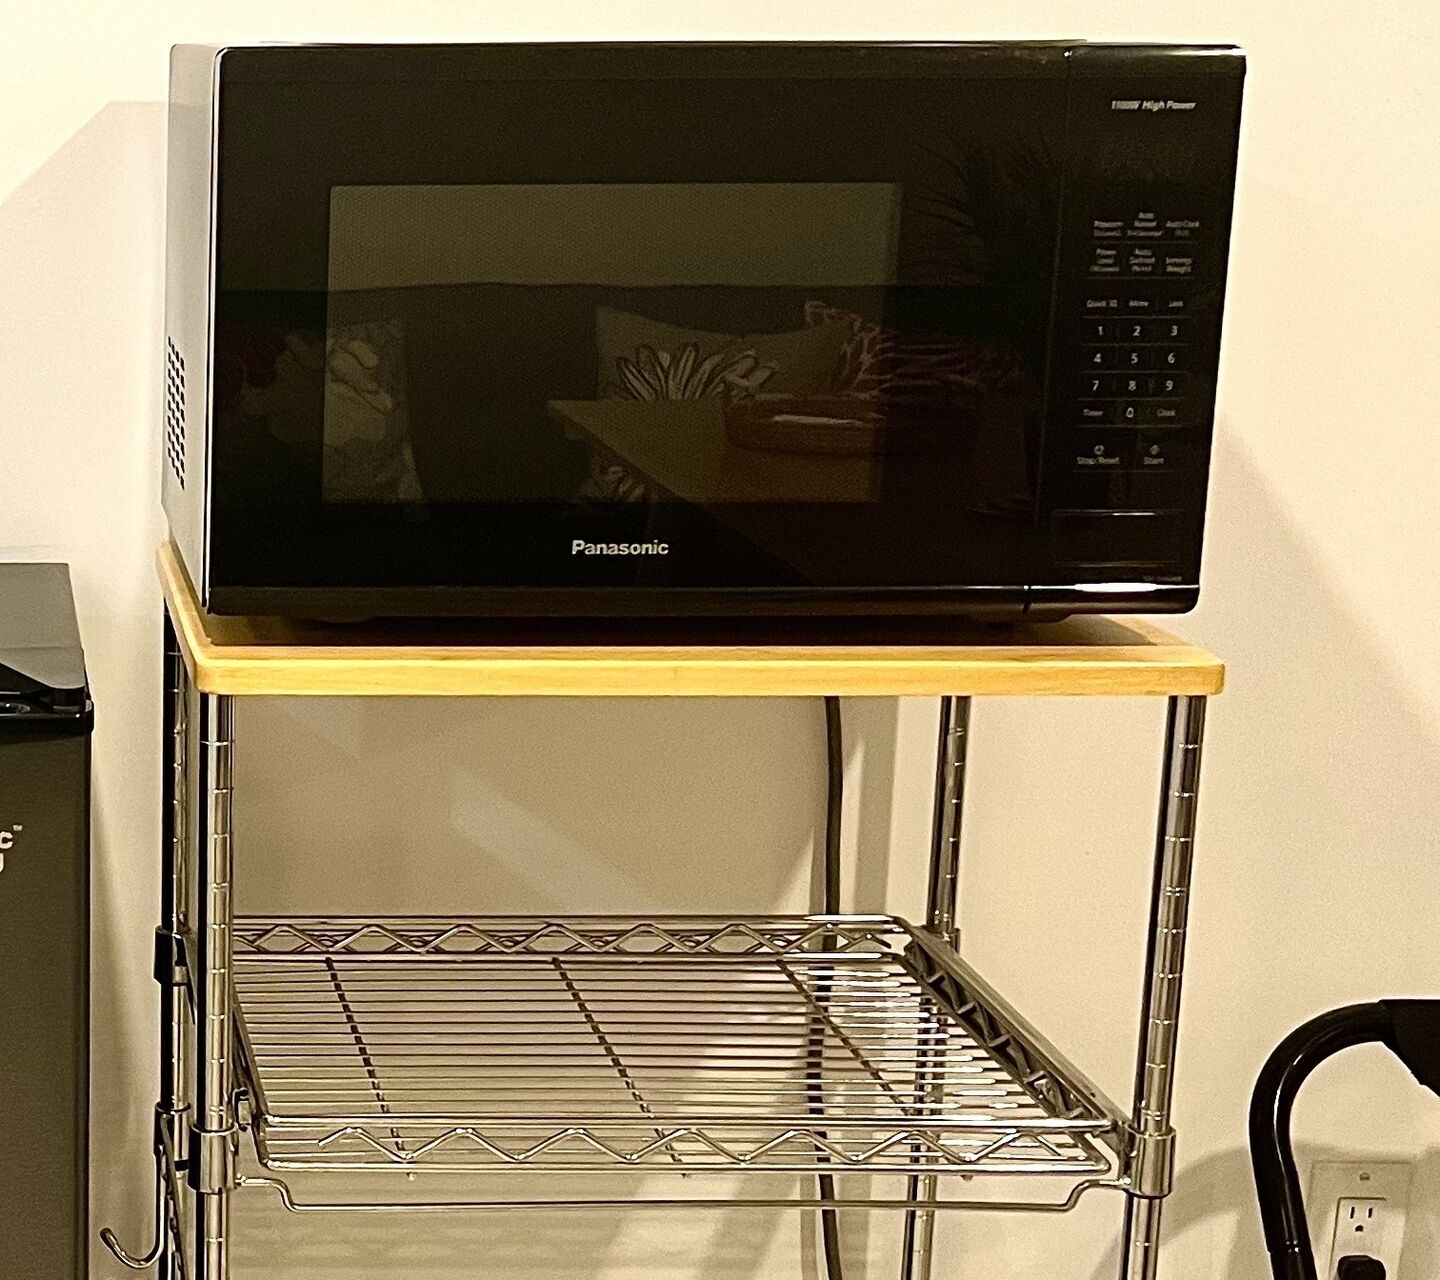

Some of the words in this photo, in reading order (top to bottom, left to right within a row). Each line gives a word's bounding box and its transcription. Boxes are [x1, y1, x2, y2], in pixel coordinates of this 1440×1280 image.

[1142, 100, 1165, 112] High
[1166, 100, 1197, 110] Power
[1097, 325, 1104, 336] 1
[1132, 325, 1141, 337] 2
[1170, 325, 1178, 337] 3
[1093, 352, 1102, 363] 4
[1131, 352, 1139, 364] 5
[1167, 352, 1175, 364] 6
[1092, 380, 1099, 391] 7
[1128, 380, 1137, 391] 8
[1165, 380, 1174, 391] 9
[1125, 407, 1134, 418] 0
[571, 539, 669, 555] Panasonic
